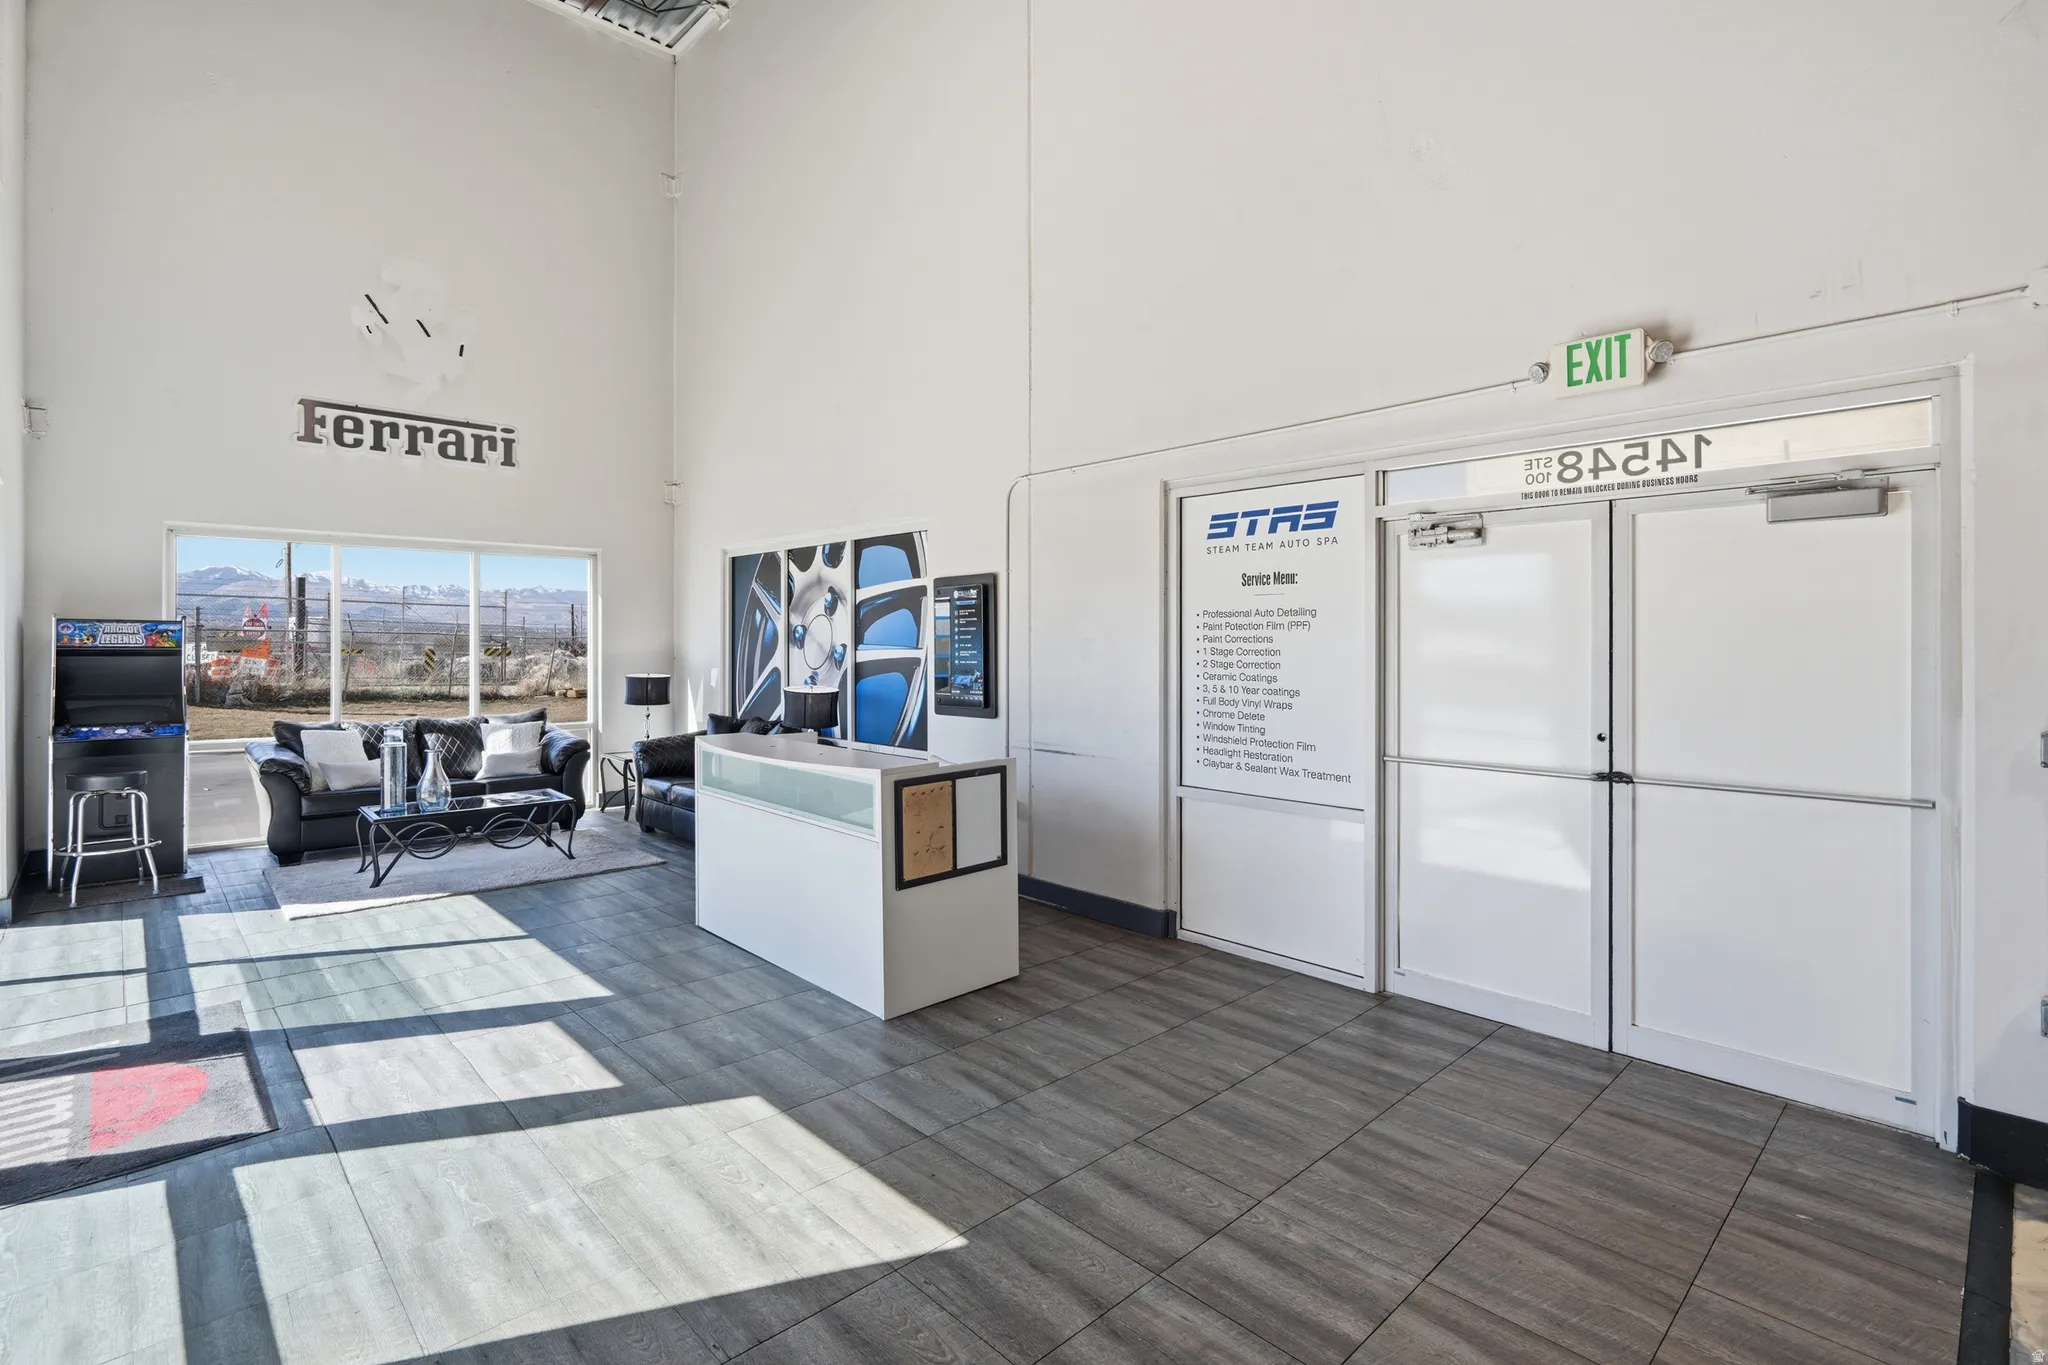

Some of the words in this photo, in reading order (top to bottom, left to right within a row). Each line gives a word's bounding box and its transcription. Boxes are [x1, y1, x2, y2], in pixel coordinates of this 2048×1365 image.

[1567, 333, 1631, 387] EXIT
[297, 398, 516, 467] Ferrari
[1521, 491, 1533, 500] THIS
[1534, 490, 1550, 499] DOOR
[1551, 489, 1559, 497] TO
[1560, 487, 1582, 496] REMAIN
[1584, 483, 1615, 494] UNLOCKED
[1616, 481, 1640, 490] DURING
[1642, 476, 1674, 487] BUSINESS
[1675, 474, 1698, 484] HOURS
[1207, 500, 1339, 540] STAS
[1206, 545, 1240, 554] STEAM
[1245, 542, 1273, 552] TEAM
[1279, 538, 1310, 549] AUTO
[1316, 536, 1339, 546] SPA
[1241, 572, 1271, 587] Service
[1273, 571, 1298, 585] Menu:
[1202, 609, 1252, 618] Professional
[1254, 608, 1275, 618] Auto
[1277, 607, 1317, 618] Detailing
[104, 624, 138, 634] ARCADE
[1202, 622, 1223, 631] Paint
[1224, 621, 1263, 631] Potection
[1266, 621, 1284, 630] Film
[1287, 620, 1311, 632] (PPF)
[100, 634, 143, 644] LEGENDS
[1202, 634, 1223, 643] Paint
[1224, 634, 1274, 644] Corrections
[1210, 647, 1234, 658] Stage
[1236, 647, 1281, 657] Correction
[1203, 660, 1208, 668] 2
[1210, 660, 1234, 670] Stage
[1236, 660, 1281, 669] Correction
[1203, 671, 1237, 681] Ceramic
[1239, 672, 1278, 684] Coatings
[1202, 685, 1210, 694] 3,
[1212, 685, 1218, 693] 5
[1220, 685, 1226, 694] &
[1228, 685, 1239, 694] 10
[1241, 686, 1260, 695] Year
[1262, 687, 1300, 699] coatings
[1202, 696, 1217, 705] Full
[1218, 697, 1240, 708] Body
[1241, 699, 1261, 709] Vinyl
[1263, 700, 1293, 711] Wraps
[1202, 708, 1235, 719] Chrome
[1237, 710, 1266, 721] Delete
[1202, 721, 1235, 732] Window
[1237, 723, 1266, 736] Tinting
[1202, 733, 1248, 746] Windshield
[1250, 737, 1294, 750] Protection
[1296, 741, 1316, 752] Film
[1202, 746, 1242, 758] Headlight
[1243, 750, 1293, 763] Restoration
[1202, 758, 1234, 770] Claybar
[1236, 762, 1242, 771] &
[1244, 762, 1277, 775] Sealant
[1279, 767, 1300, 778] Wax
[1302, 769, 1351, 784] Treatment
